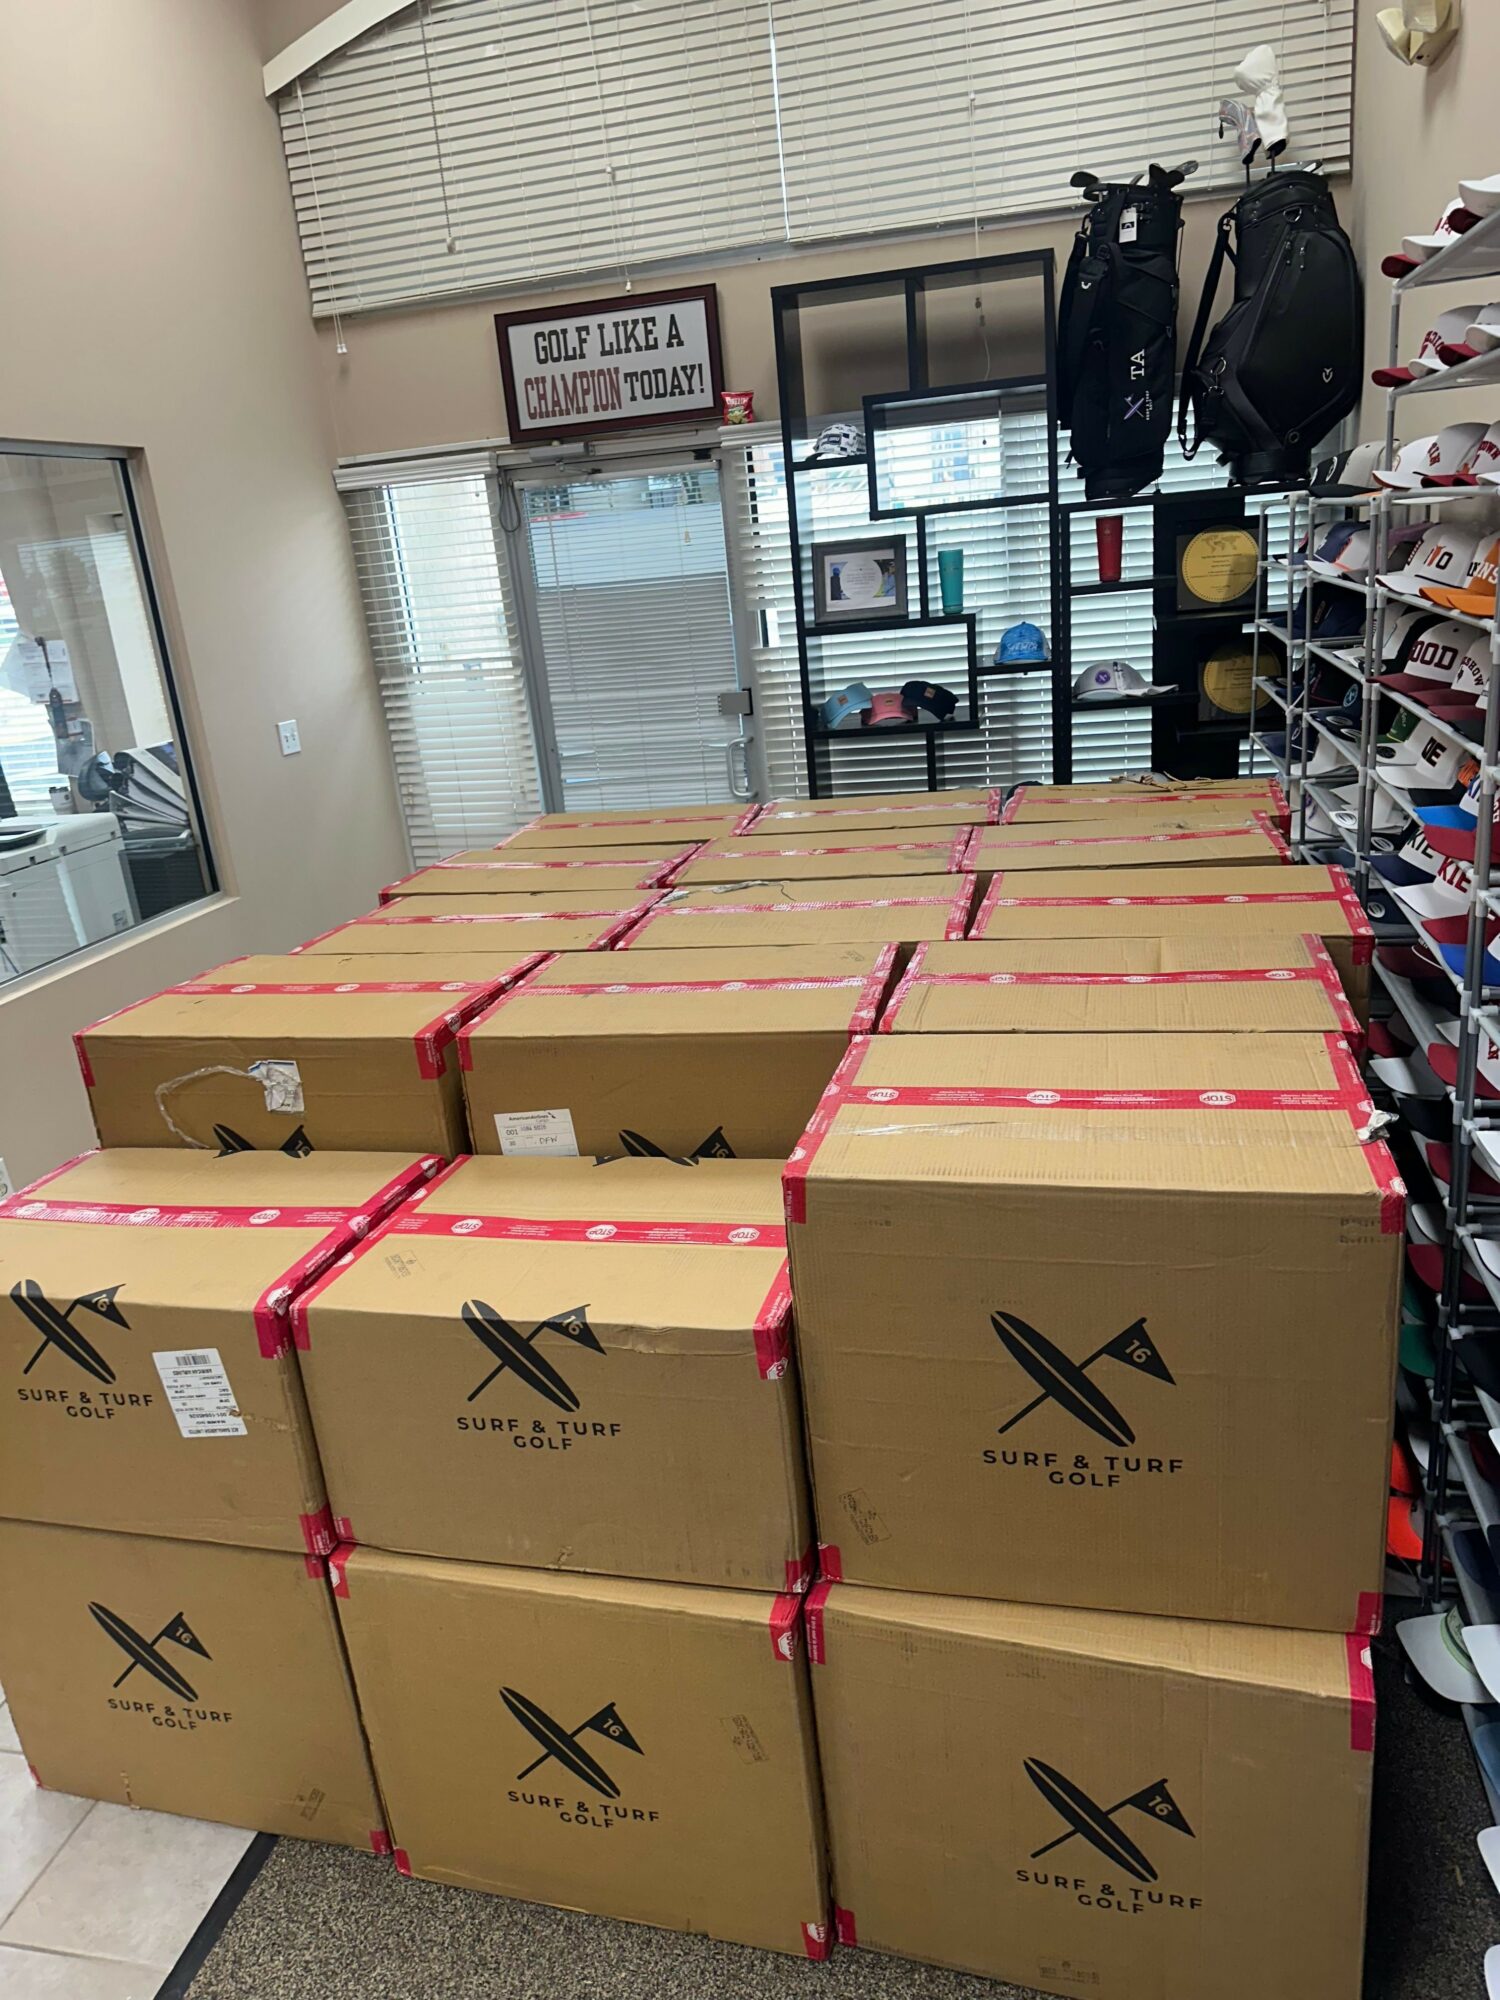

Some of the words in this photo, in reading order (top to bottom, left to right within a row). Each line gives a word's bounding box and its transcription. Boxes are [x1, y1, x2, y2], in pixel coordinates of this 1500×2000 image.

[534, 325, 591, 365] GOLF
[597, 316, 659, 357] LIKE
[666, 313, 684, 348] A
[1130, 349, 1145, 380] TA
[524, 366, 623, 420] CHAMPION
[623, 363, 705, 402] TODAY!
[1203, 1094, 1234, 1102] STOP
[457, 1219, 480, 1232] STOP
[589, 1226, 615, 1238] STOP
[732, 1229, 758, 1242] STOP
[91, 1294, 110, 1312] 16
[561, 1315, 584, 1336] 16
[1124, 1339, 1152, 1364] 16
[18, 1388, 69, 1402] SURF
[81, 1391, 95, 1404] &
[99, 1392, 153, 1407] TURF
[67, 1405, 115, 1420] GOLF
[457, 1416, 519, 1432] SURF
[532, 1420, 546, 1434] &
[557, 1420, 621, 1437] TURF
[513, 1435, 573, 1450] GOLF
[983, 1450, 1058, 1467] SURF
[1073, 1455, 1090, 1469] &
[1104, 1456, 1184, 1473] TURF
[1049, 1471, 1121, 1487] GOLF
[174, 1626, 193, 1645] 16
[107, 1698, 155, 1713] SURF
[164, 1705, 176, 1716] &
[182, 1707, 233, 1723] TURF
[152, 1715, 197, 1730] GOLF
[602, 1718, 623, 1737] 16
[507, 1790, 564, 1808] SURF
[576, 1801, 589, 1813] &
[600, 1804, 660, 1822] TURF
[1147, 1795, 1173, 1816] 16
[560, 1812, 615, 1828] GOLF
[1016, 1869, 1086, 1890] SURF
[1100, 1883, 1115, 1896] &
[1129, 1887, 1203, 1910] TURF
[1077, 1894, 1145, 1914] GOLF
